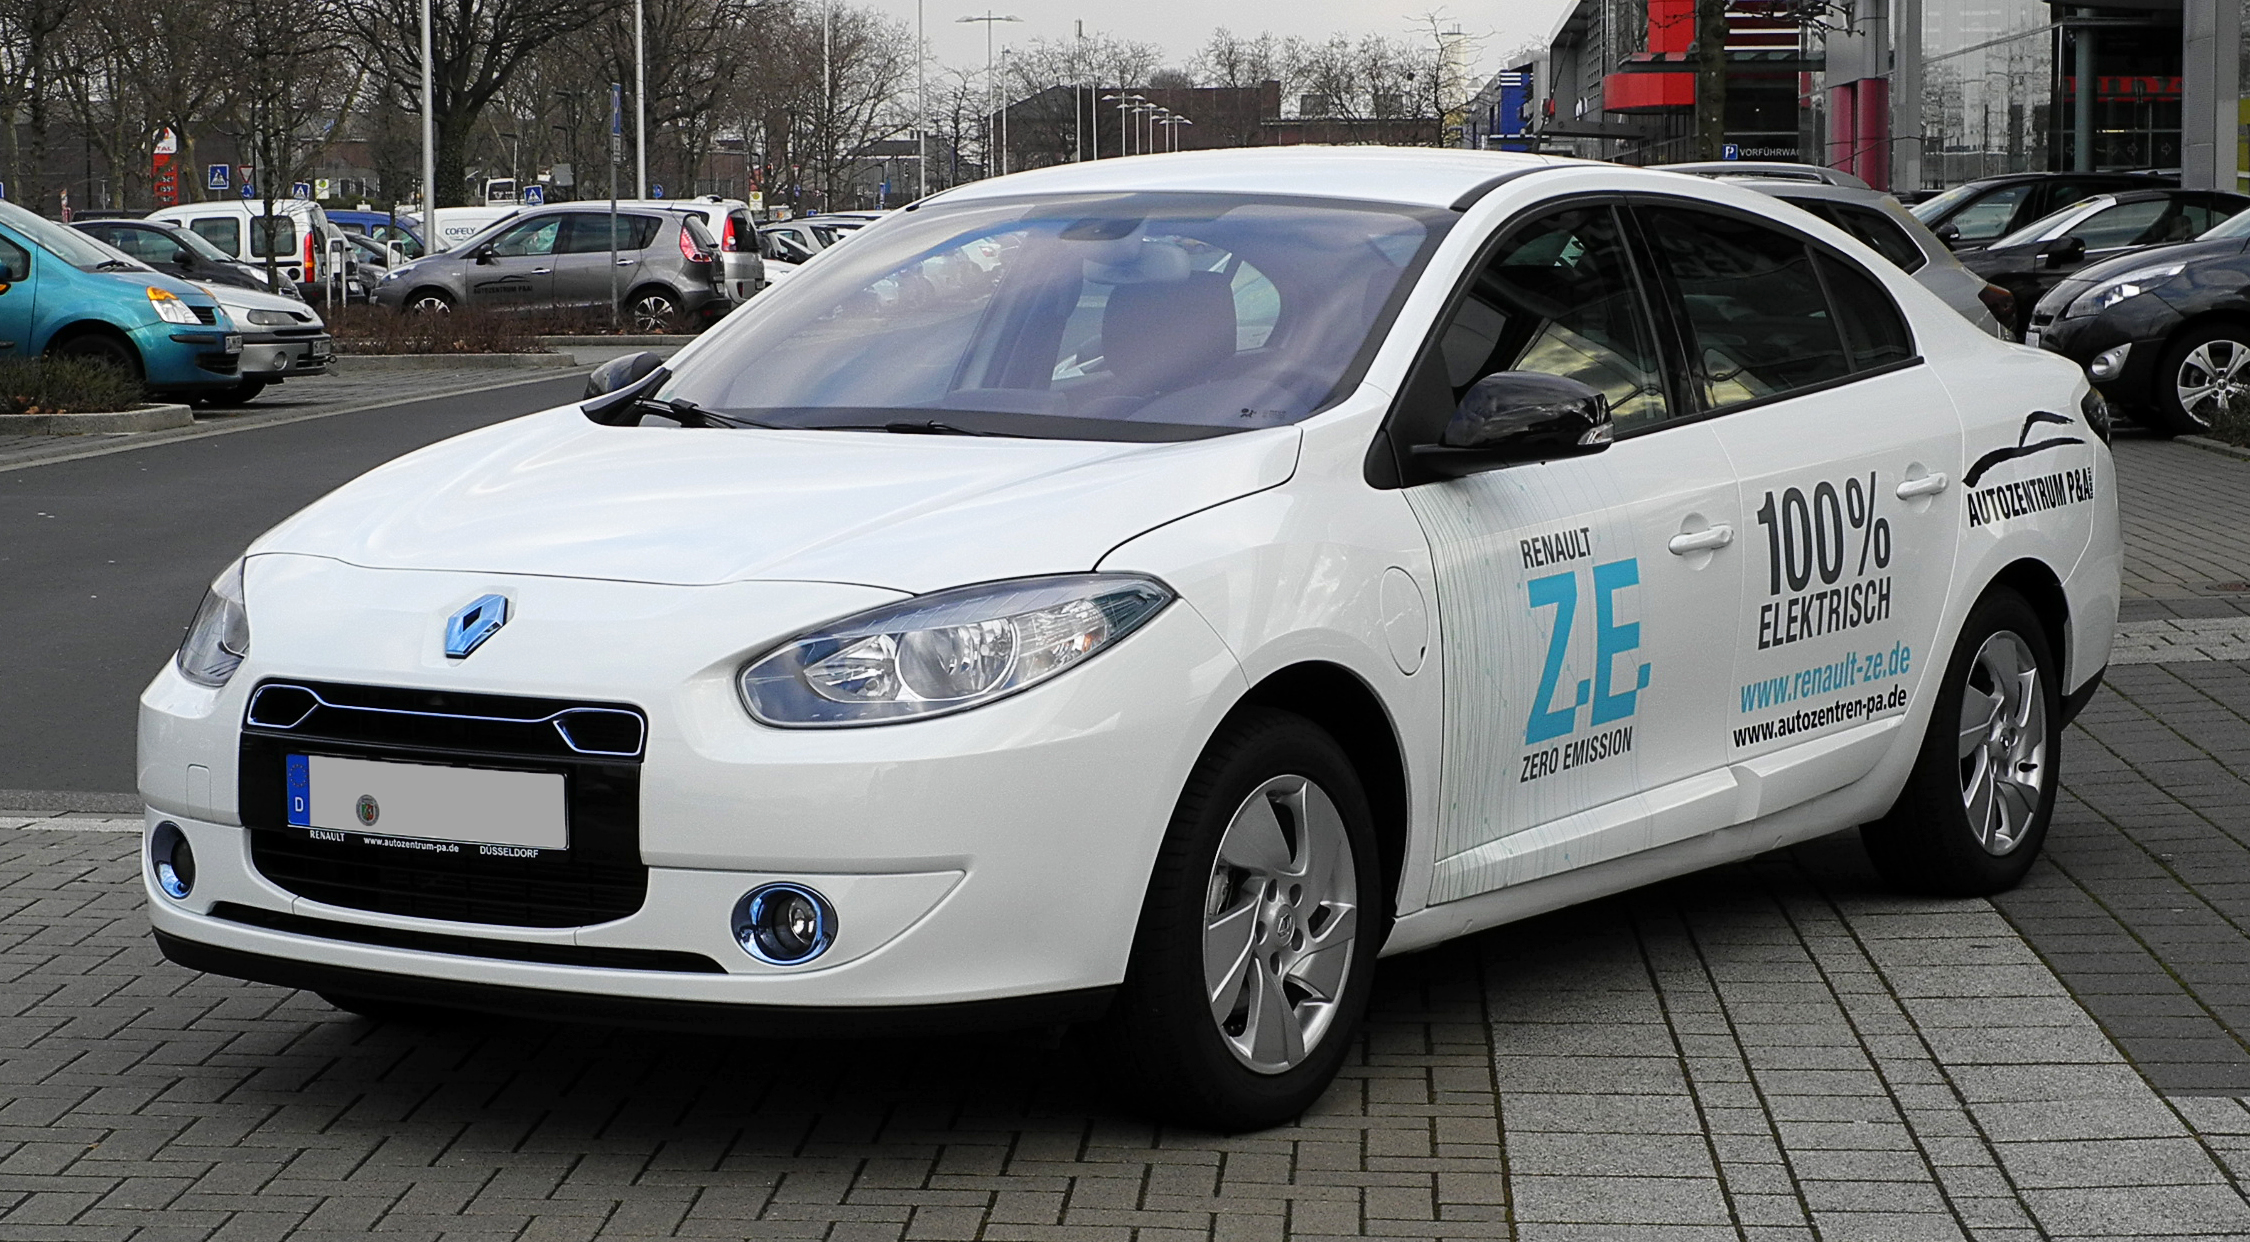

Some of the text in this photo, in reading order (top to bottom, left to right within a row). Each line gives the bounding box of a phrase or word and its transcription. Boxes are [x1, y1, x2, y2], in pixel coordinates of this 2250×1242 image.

[445, 227, 476, 236] COFELY
[1967, 473, 2067, 528] AUTOZENTRUM
[2066, 467, 2091, 503] P&A
[1520, 527, 1591, 569] RENAULT
[1757, 471, 1891, 596] 100%
[1758, 576, 1891, 650] ELEKTRISCH
[1741, 640, 1911, 713] www.renault-ze.de
[1733, 684, 1907, 748] www.autozentren-pa.de
[1520, 726, 1633, 783] ZERO EMISSION
[294, 796, 304, 812] D
[309, 829, 539, 859] RENAULT www.autozentrum-pa.de DÜSSELDORF
